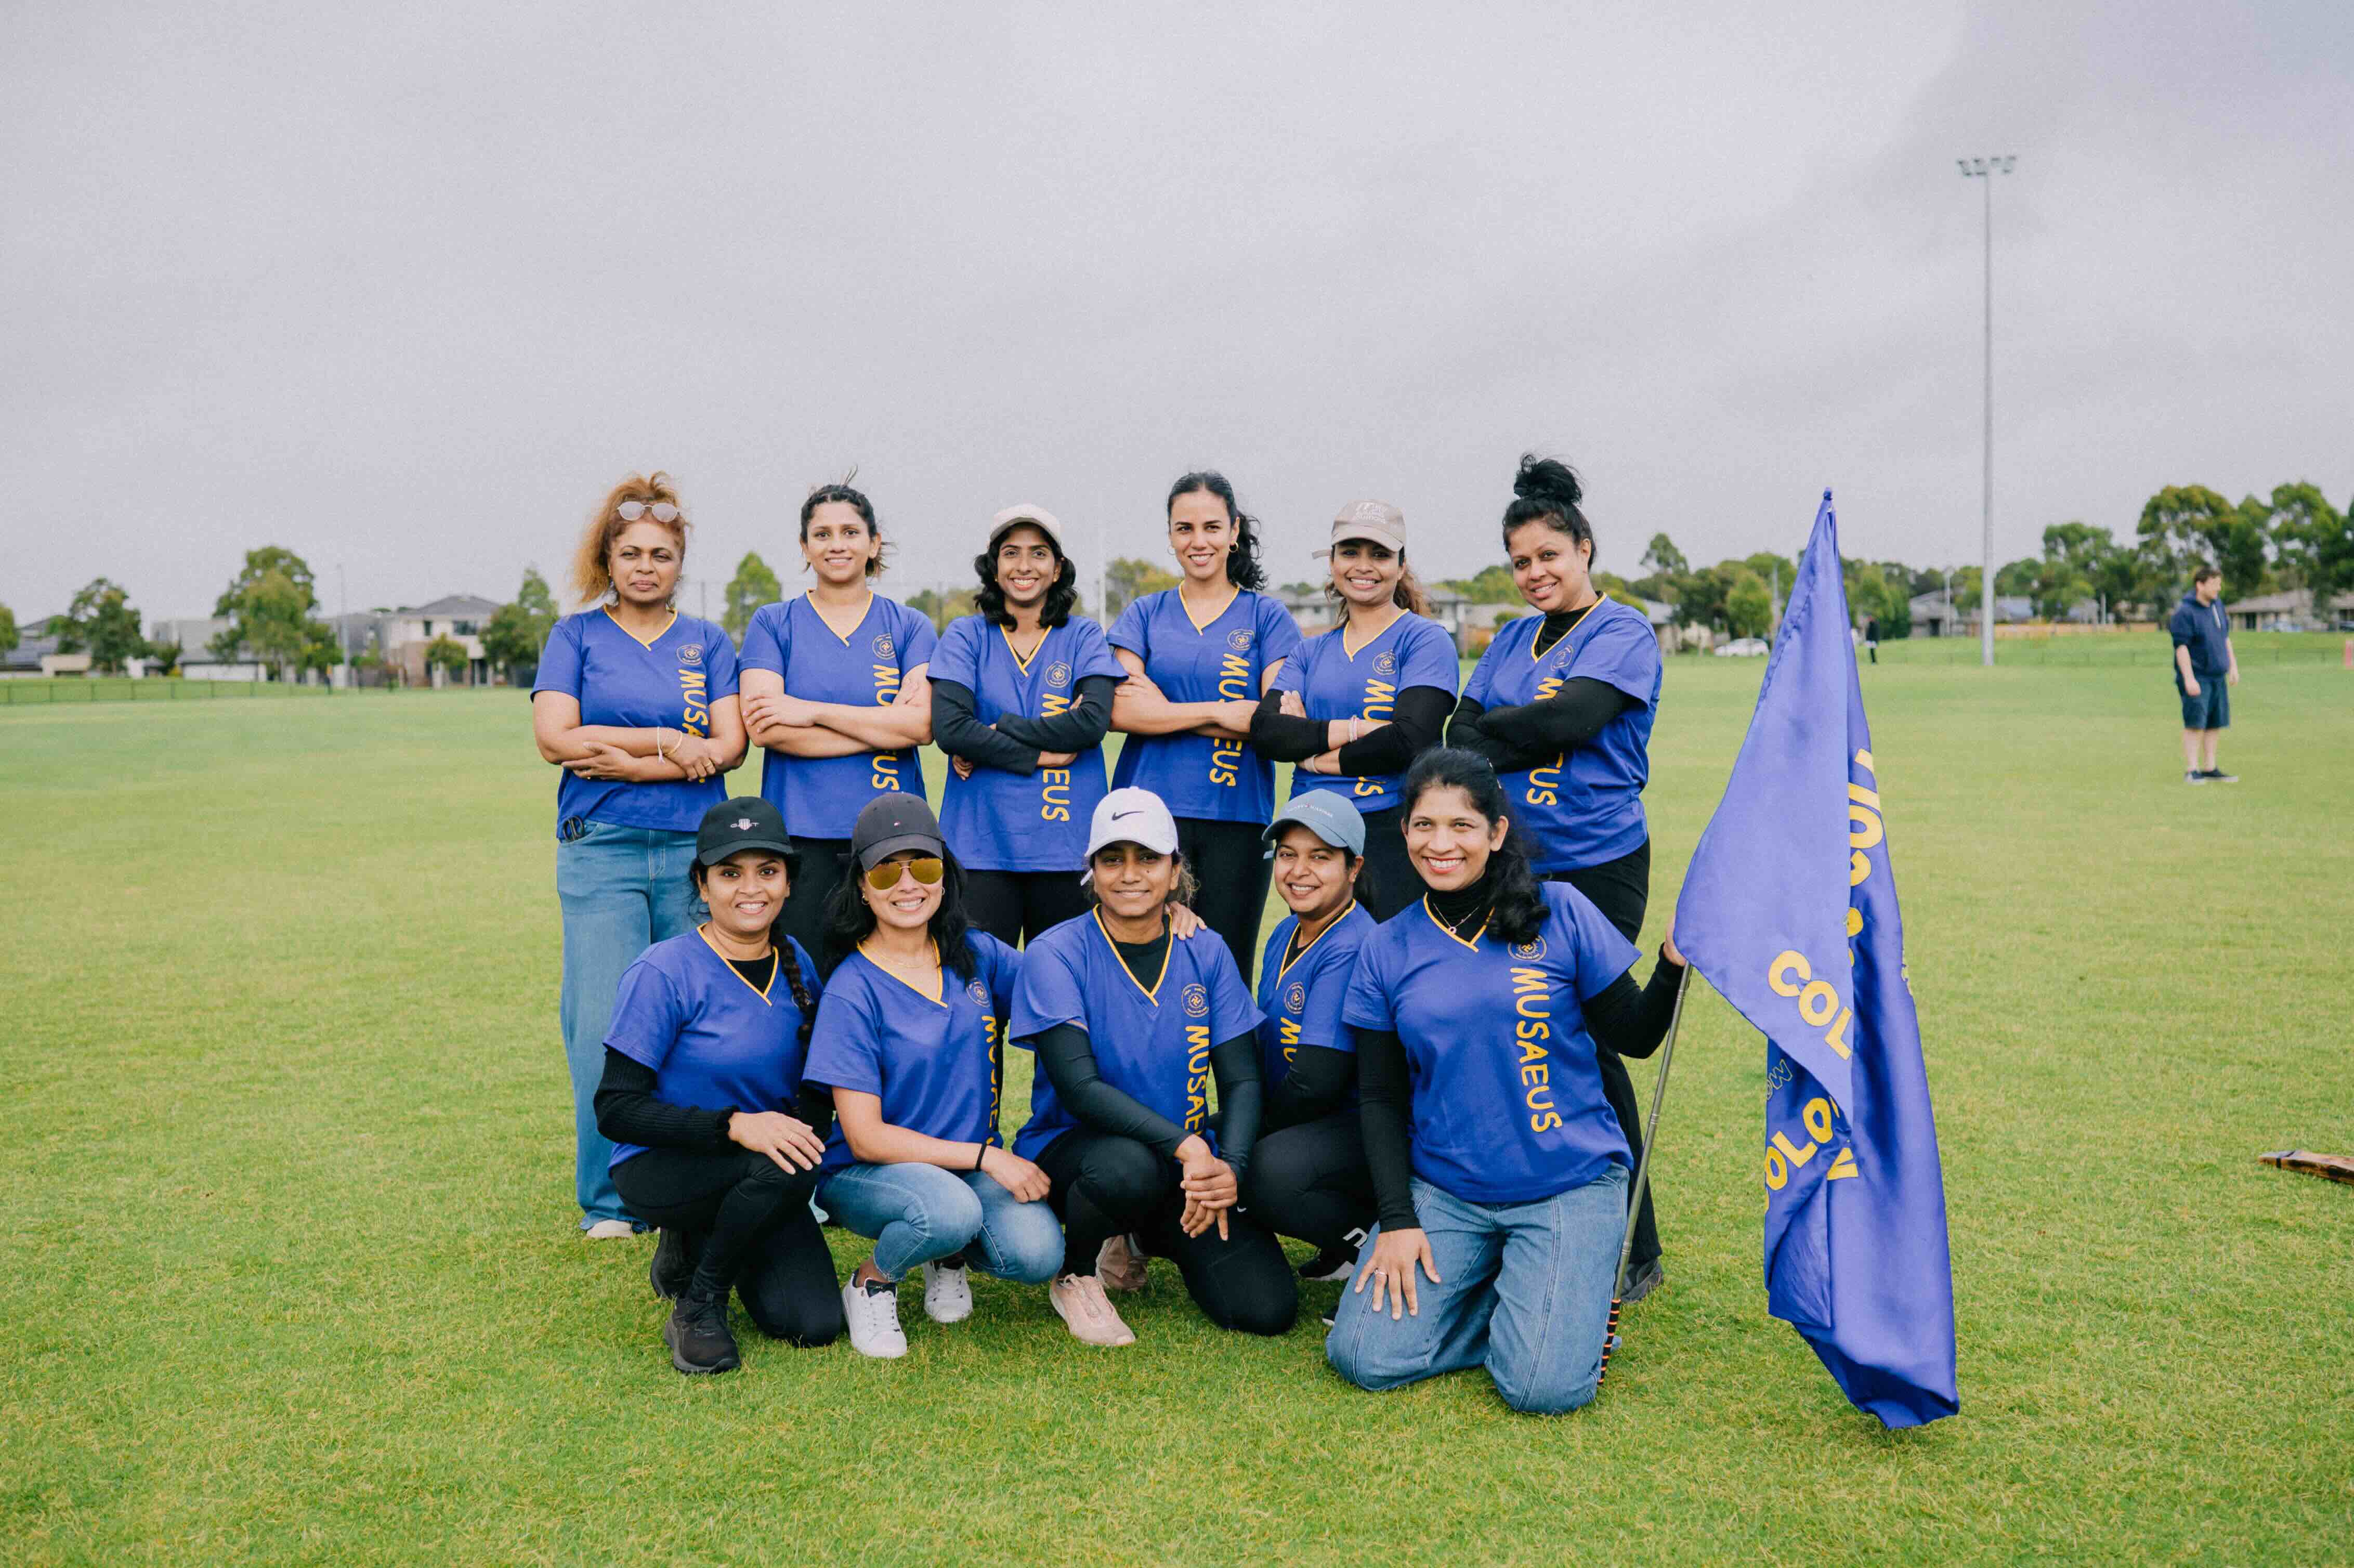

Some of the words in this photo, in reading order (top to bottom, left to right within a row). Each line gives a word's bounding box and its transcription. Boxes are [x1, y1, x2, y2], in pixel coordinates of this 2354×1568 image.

[678, 669, 709, 737] MUSA
[872, 664, 900, 791] MUUS
[1041, 693, 1070, 821] MEUS
[1185, 1025, 1210, 1136] MUSAE
[1510, 967, 1563, 1133] MUSAEUS
